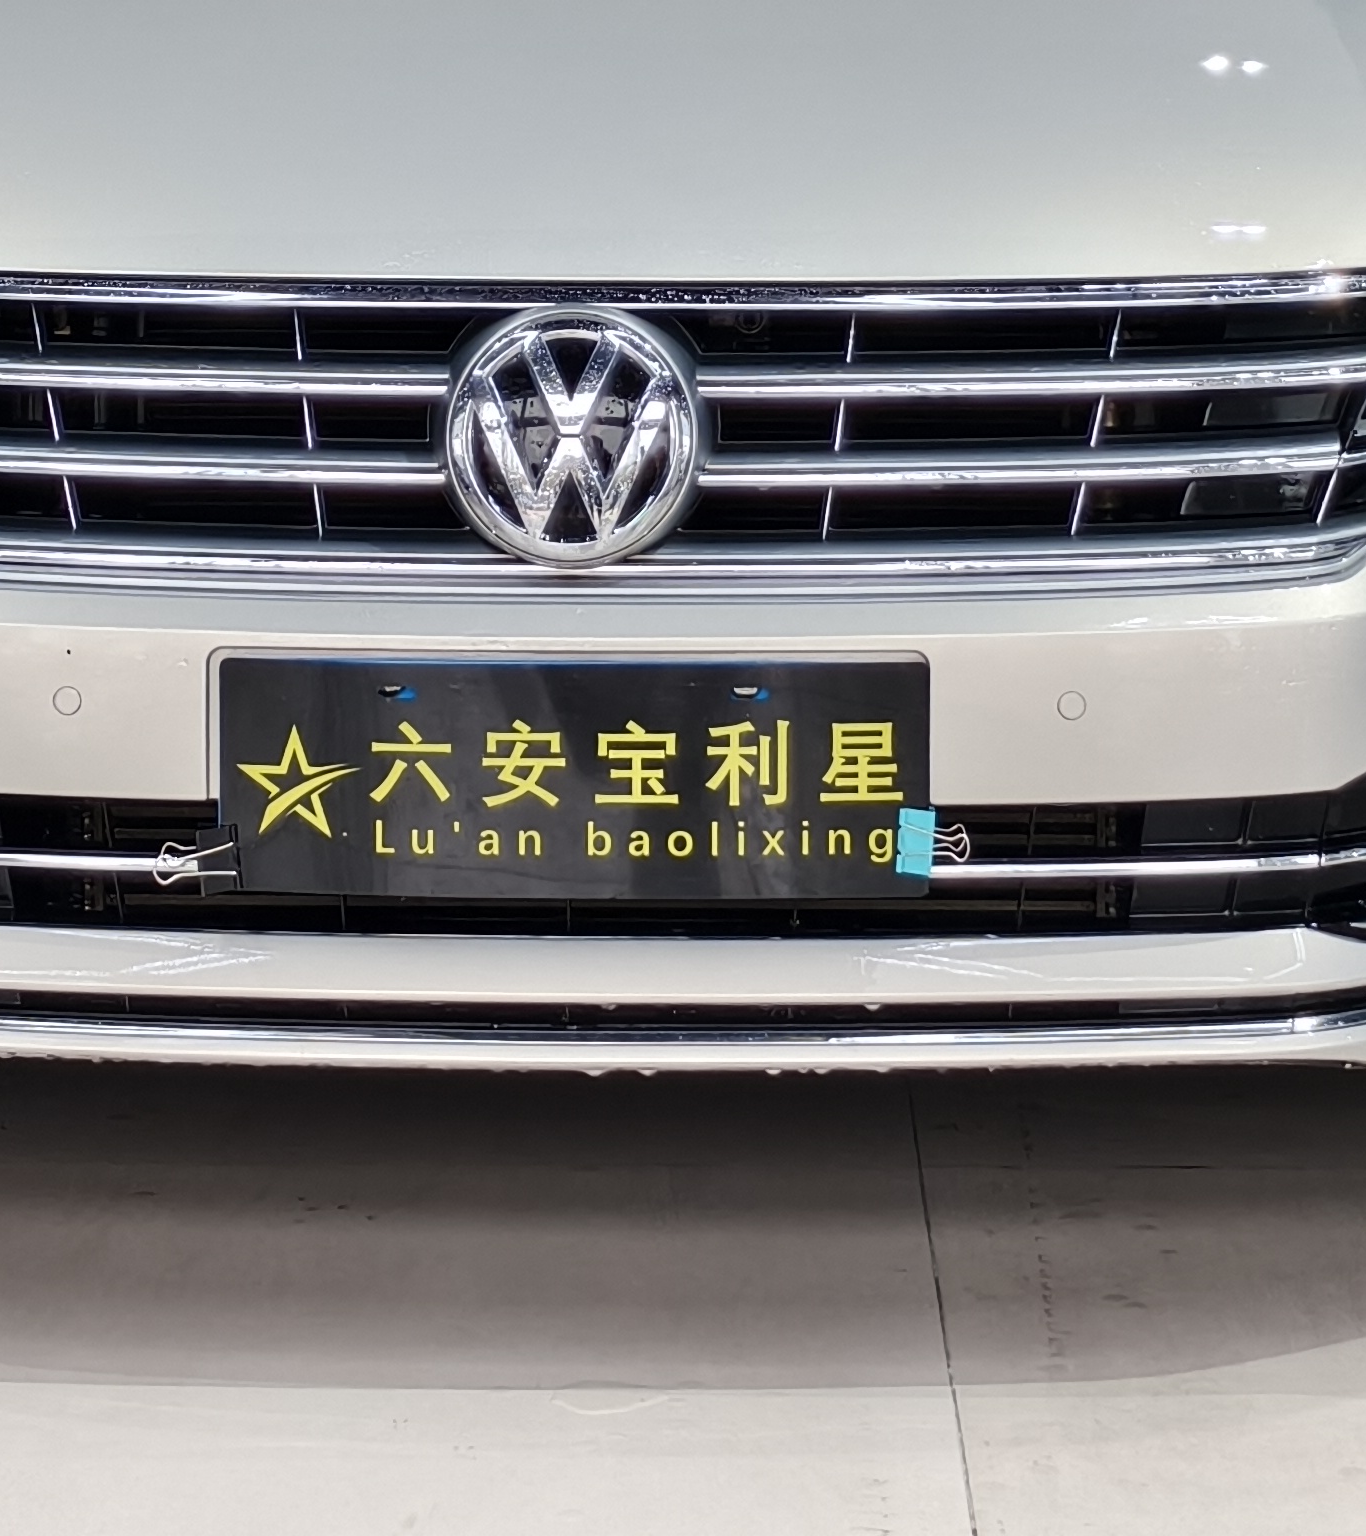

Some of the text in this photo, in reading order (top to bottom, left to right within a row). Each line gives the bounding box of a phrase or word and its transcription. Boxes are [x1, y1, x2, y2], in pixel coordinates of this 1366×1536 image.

[369, 719, 905, 809] 六安宝利星
[374, 819, 900, 864] Lu'an baolixing
